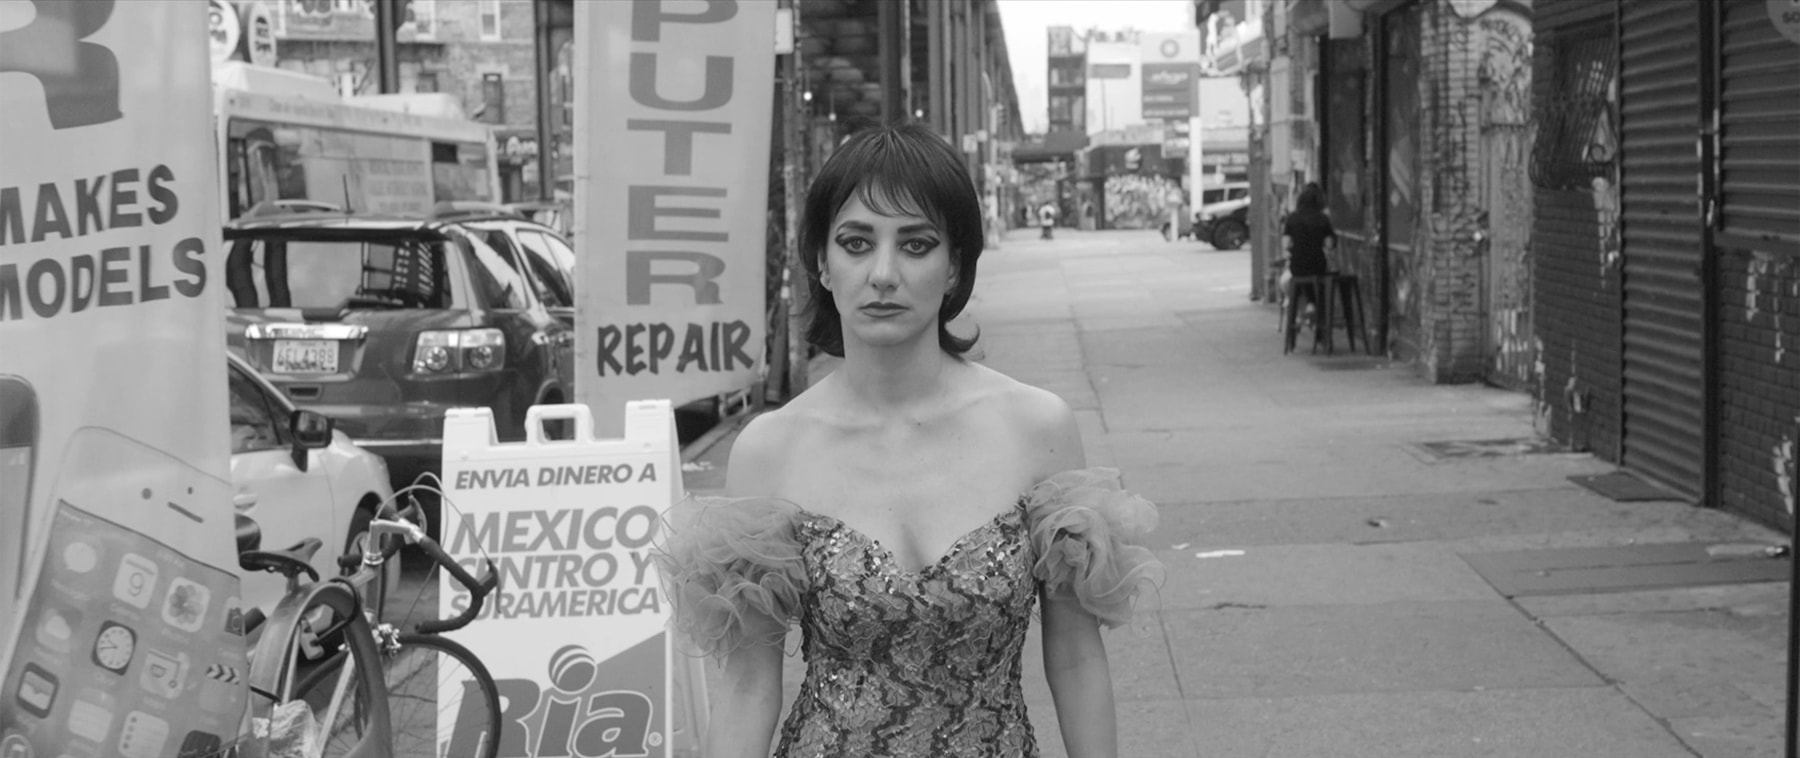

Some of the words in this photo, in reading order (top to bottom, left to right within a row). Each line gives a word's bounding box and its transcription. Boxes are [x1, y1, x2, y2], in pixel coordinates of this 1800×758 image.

[0, 164, 178, 246] MAKES
[596, 319, 754, 377] REPAIR
[455, 468, 530, 490] ENVIA
[537, 463, 633, 487] DINERO
[638, 463, 657, 482] A
[451, 505, 660, 555] MEXICO
[629, 551, 654, 585] Y
[448, 587, 661, 621] SURAMERICA
[441, 645, 653, 758] Ria
